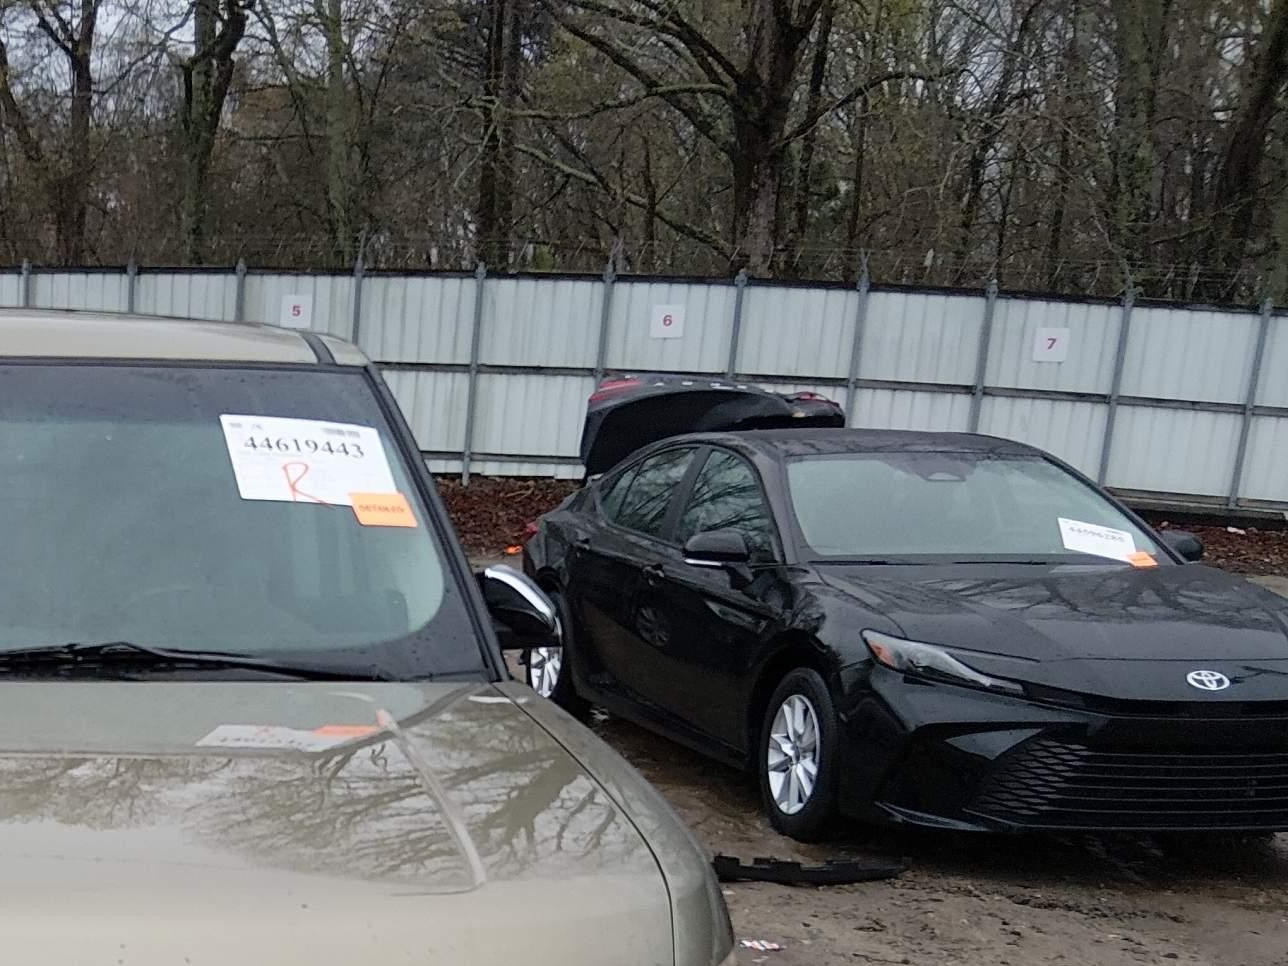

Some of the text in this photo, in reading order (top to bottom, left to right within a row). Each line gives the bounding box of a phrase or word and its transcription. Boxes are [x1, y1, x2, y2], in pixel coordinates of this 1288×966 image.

[291, 305, 301, 317] 5
[662, 314, 673, 327] 6
[1046, 337, 1057, 350] 7
[244, 435, 365, 459] 44619443
[281, 461, 337, 509] R
